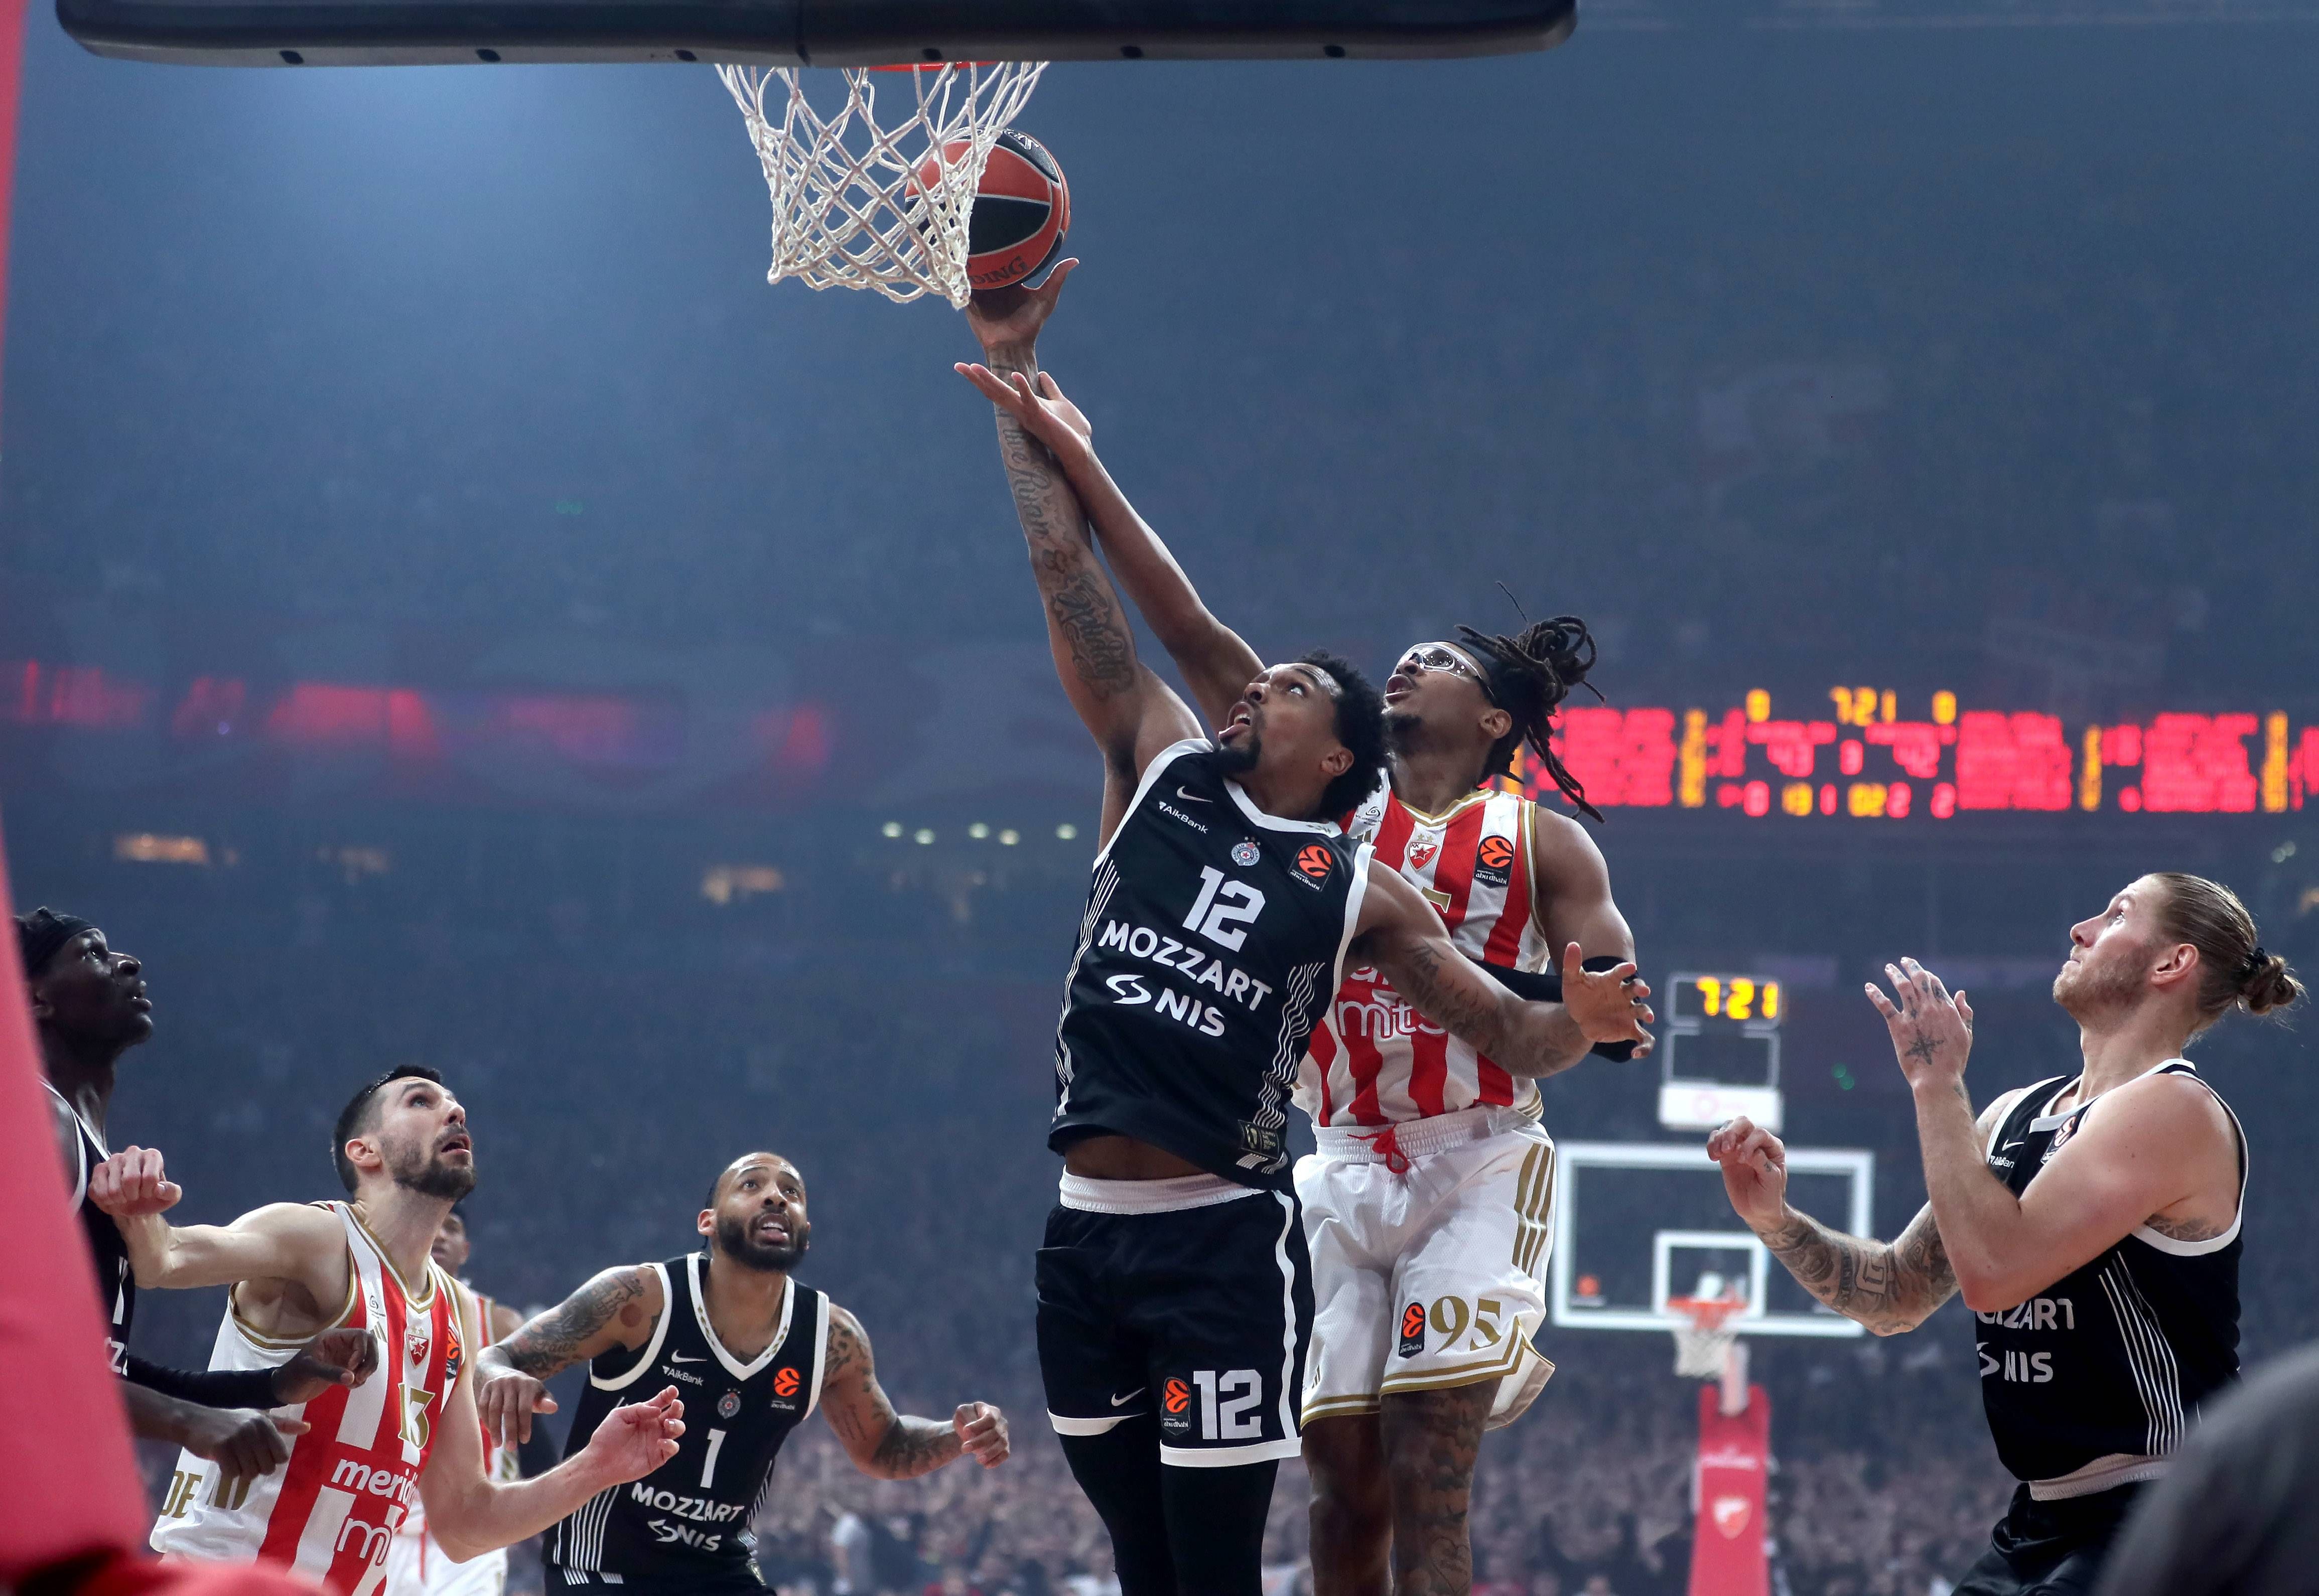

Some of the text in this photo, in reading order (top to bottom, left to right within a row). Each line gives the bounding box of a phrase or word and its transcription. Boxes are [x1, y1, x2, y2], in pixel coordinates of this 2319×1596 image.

[1163, 805, 1208, 834] AikBank
[1488, 875, 1508, 885] dhabi
[1182, 864, 1266, 952] 12
[1098, 920, 1272, 1011] MOZZART
[1154, 988, 1225, 1037] NIS
[1429, 1295, 1502, 1355] 95
[667, 1369, 704, 1386] AikBank
[2004, 1350, 2054, 1382] NIS
[398, 1383, 436, 1449] 13
[1193, 1369, 1262, 1439] 12
[700, 1428, 727, 1489] 1
[631, 1482, 745, 1522] MOZZART
[677, 1524, 722, 1552] NIS
